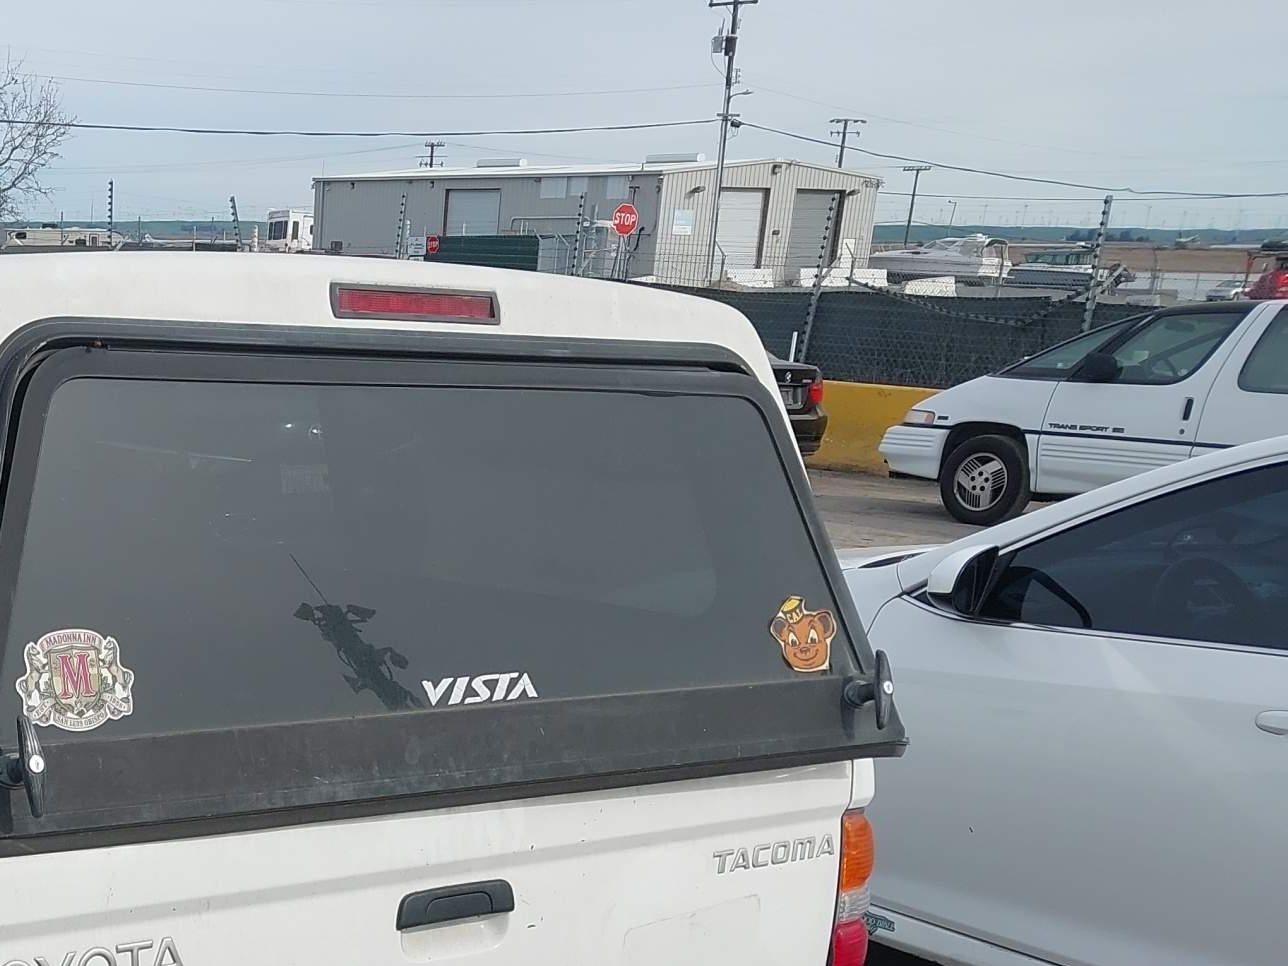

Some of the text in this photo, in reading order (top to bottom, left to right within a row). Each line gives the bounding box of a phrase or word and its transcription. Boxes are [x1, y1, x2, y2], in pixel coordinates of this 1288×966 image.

[614, 211, 636, 226] STOP
[1048, 422, 1078, 431] TRANS
[786, 608, 804, 624] CAL
[45, 633, 98, 647] MADONNA INN
[57, 652, 96, 699] M
[421, 672, 539, 706] VISTA
[56, 712, 105, 727] SAN LUIS OBISPO
[713, 834, 835, 874] TACOMA
